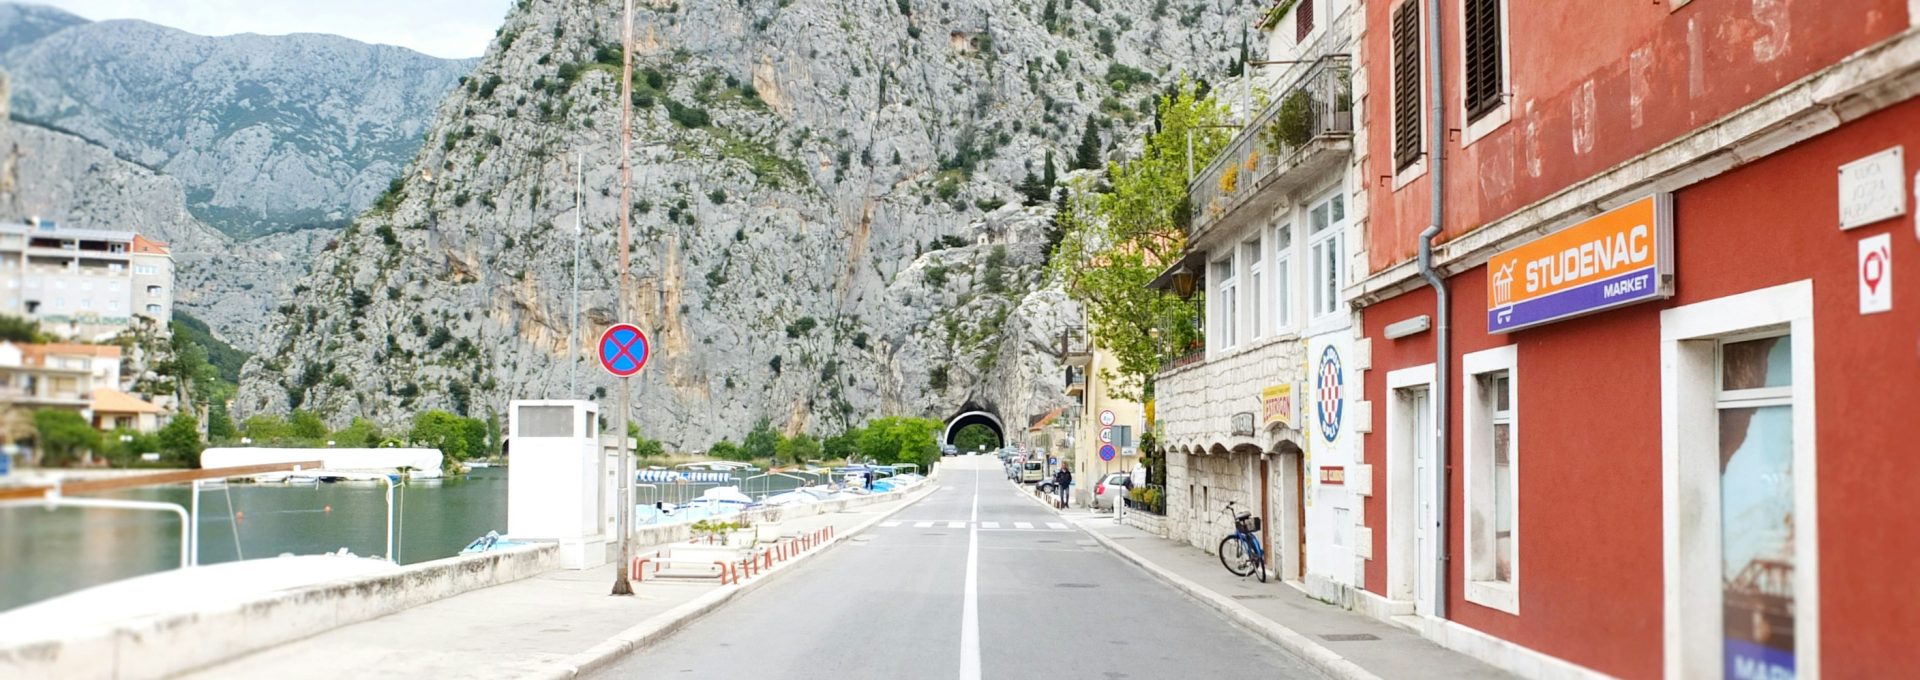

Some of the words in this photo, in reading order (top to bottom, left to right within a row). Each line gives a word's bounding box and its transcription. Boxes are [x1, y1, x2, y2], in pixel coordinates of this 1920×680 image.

[1526, 224, 1648, 293] STUDENAC
[1603, 274, 1649, 298] MARKET
[1734, 654, 1795, 680] MAR
